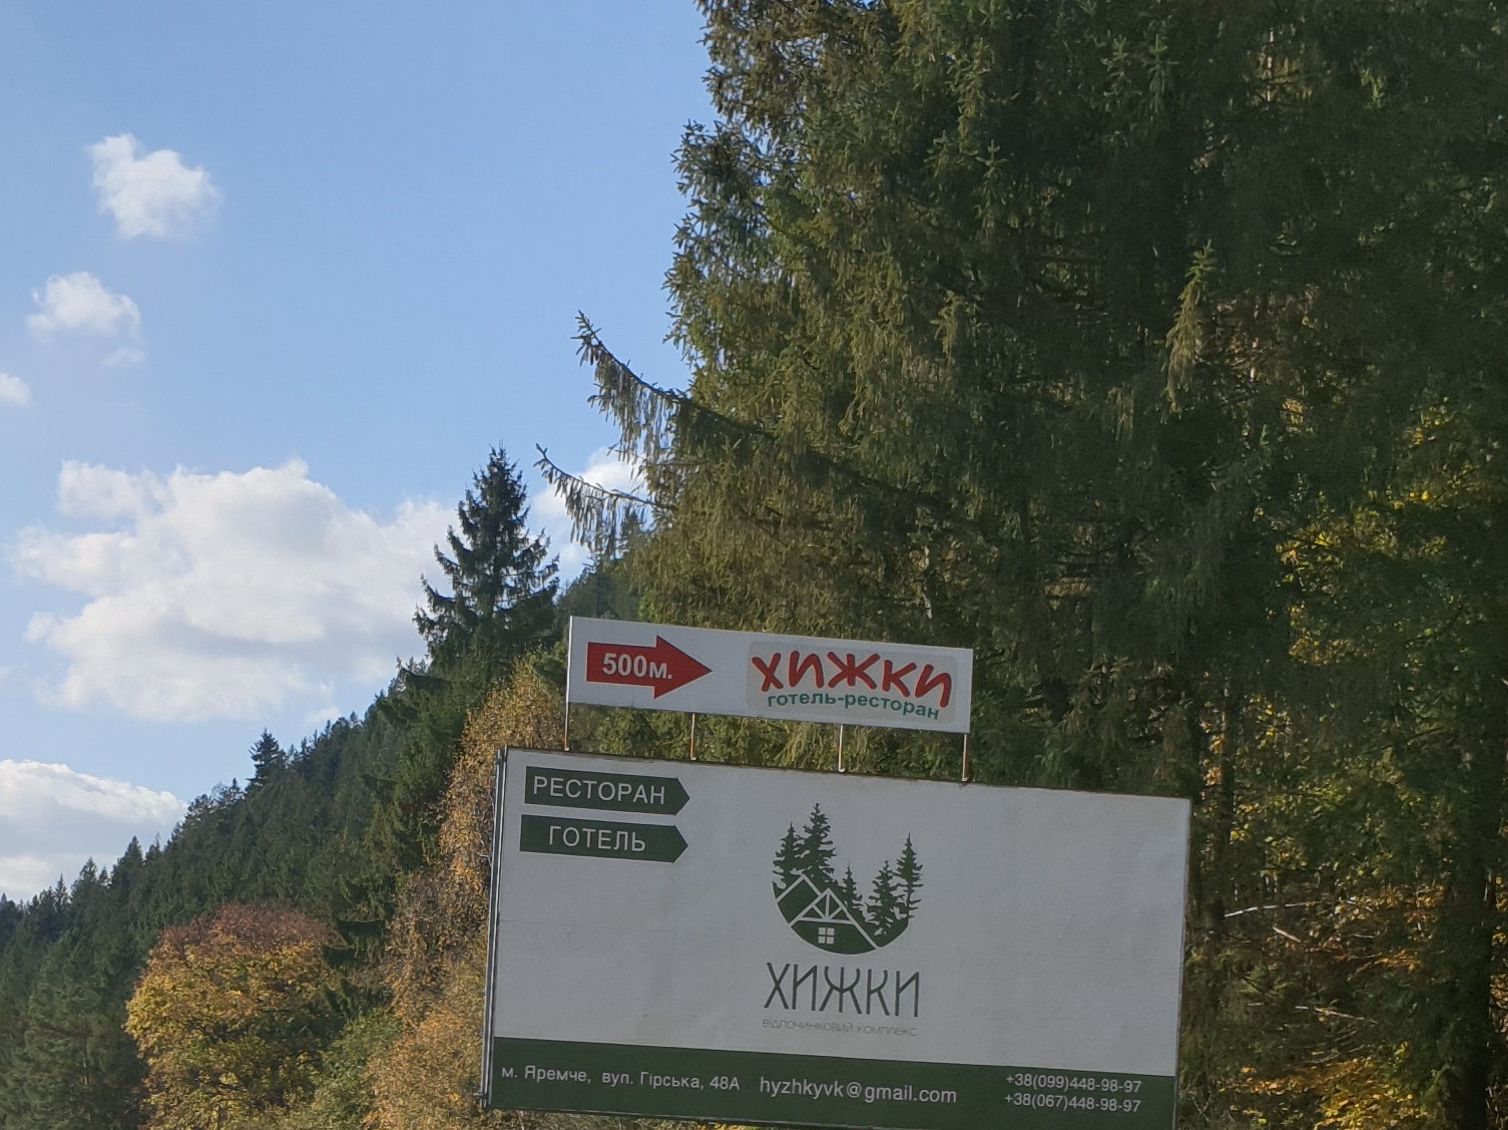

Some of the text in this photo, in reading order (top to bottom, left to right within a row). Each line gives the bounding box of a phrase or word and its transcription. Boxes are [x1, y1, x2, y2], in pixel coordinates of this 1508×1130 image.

[767, 691, 940, 721] готель-ресторан
[533, 775, 665, 805] РЕСТОРАН
[548, 825, 646, 853] ГОТЕЛЬ
[764, 962, 920, 1018] ХИЖКИ
[501, 1066, 518, 1079] м.
[524, 1065, 592, 1085] Яремче,
[602, 1072, 634, 1087] вул.
[640, 1071, 705, 1092] Гірська,
[760, 1076, 958, 1104] hyzhkyvk@gmail.com
[1005, 1073, 1142, 1094] +38(099)448-98-97
[1004, 1093, 1141, 1114] +38(067)448-98-97
